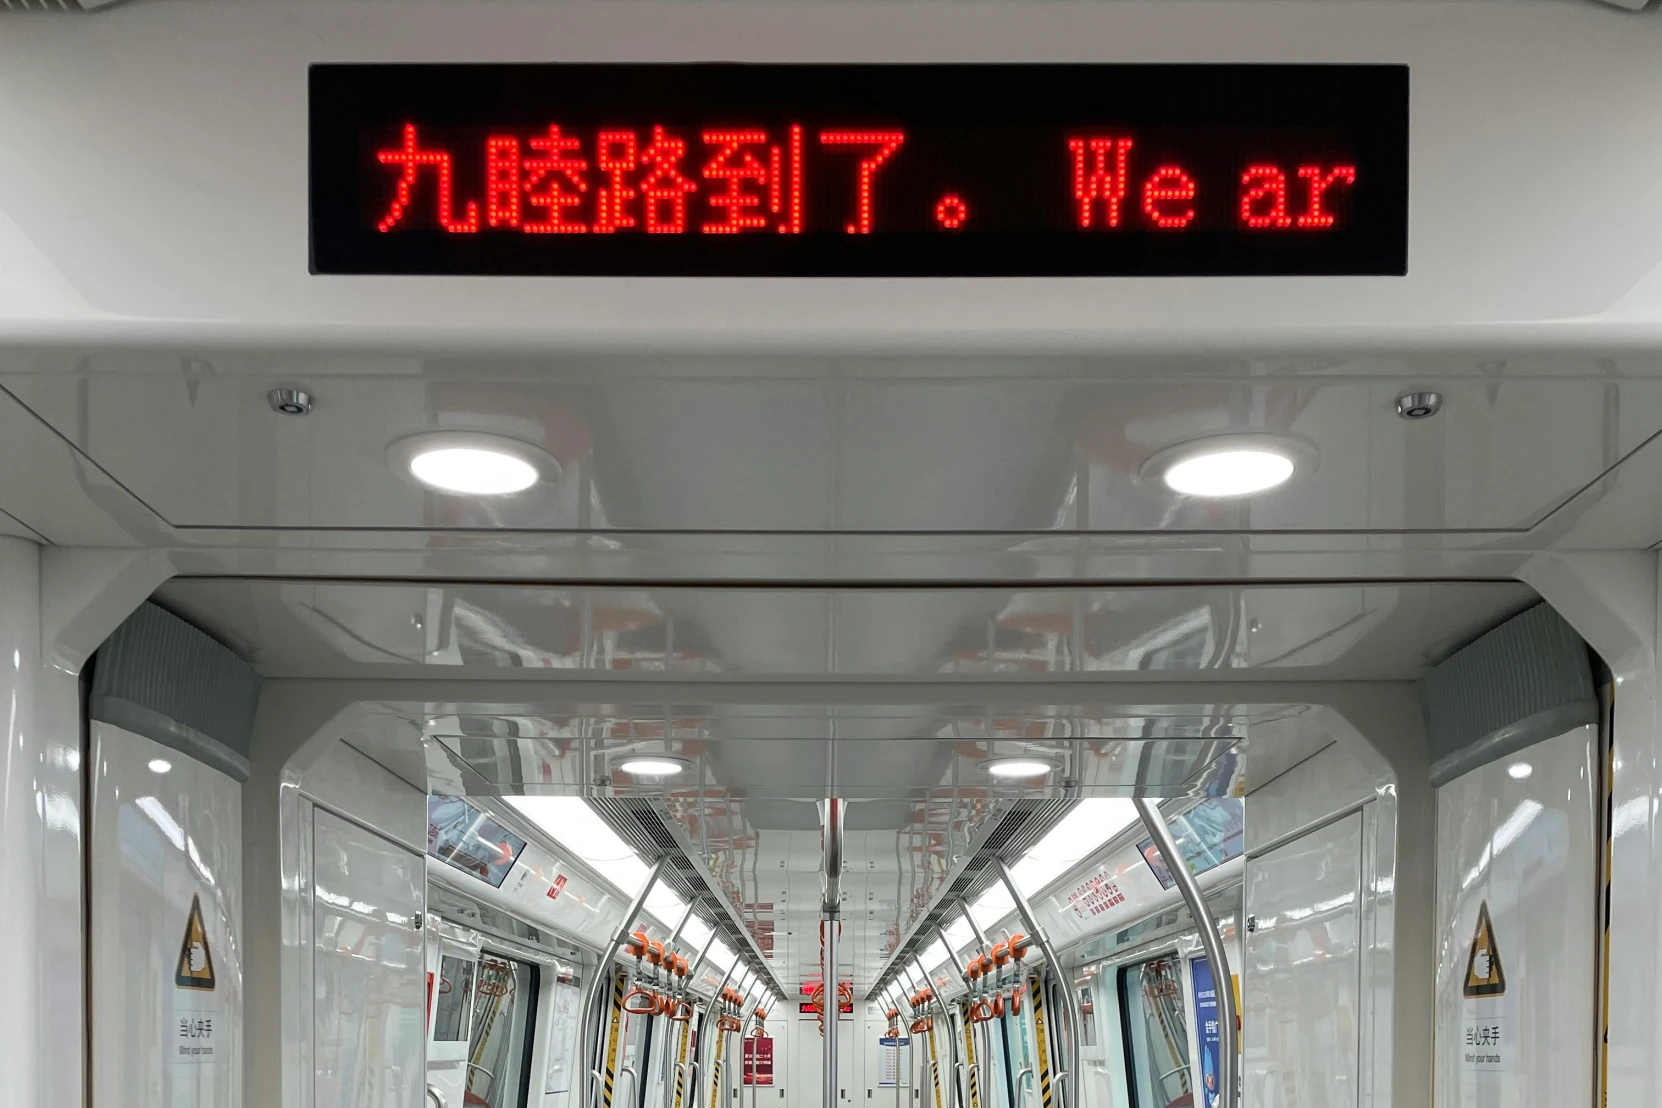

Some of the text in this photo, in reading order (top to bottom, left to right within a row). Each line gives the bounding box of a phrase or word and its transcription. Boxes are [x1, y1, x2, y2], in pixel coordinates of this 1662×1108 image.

[376, 122, 1357, 235] 九睦路到了。 We ar
[180, 1018, 212, 1038] 当心夹手
[1466, 1026, 1500, 1046] 当心夹手
[1475, 1055, 1485, 1065] your
